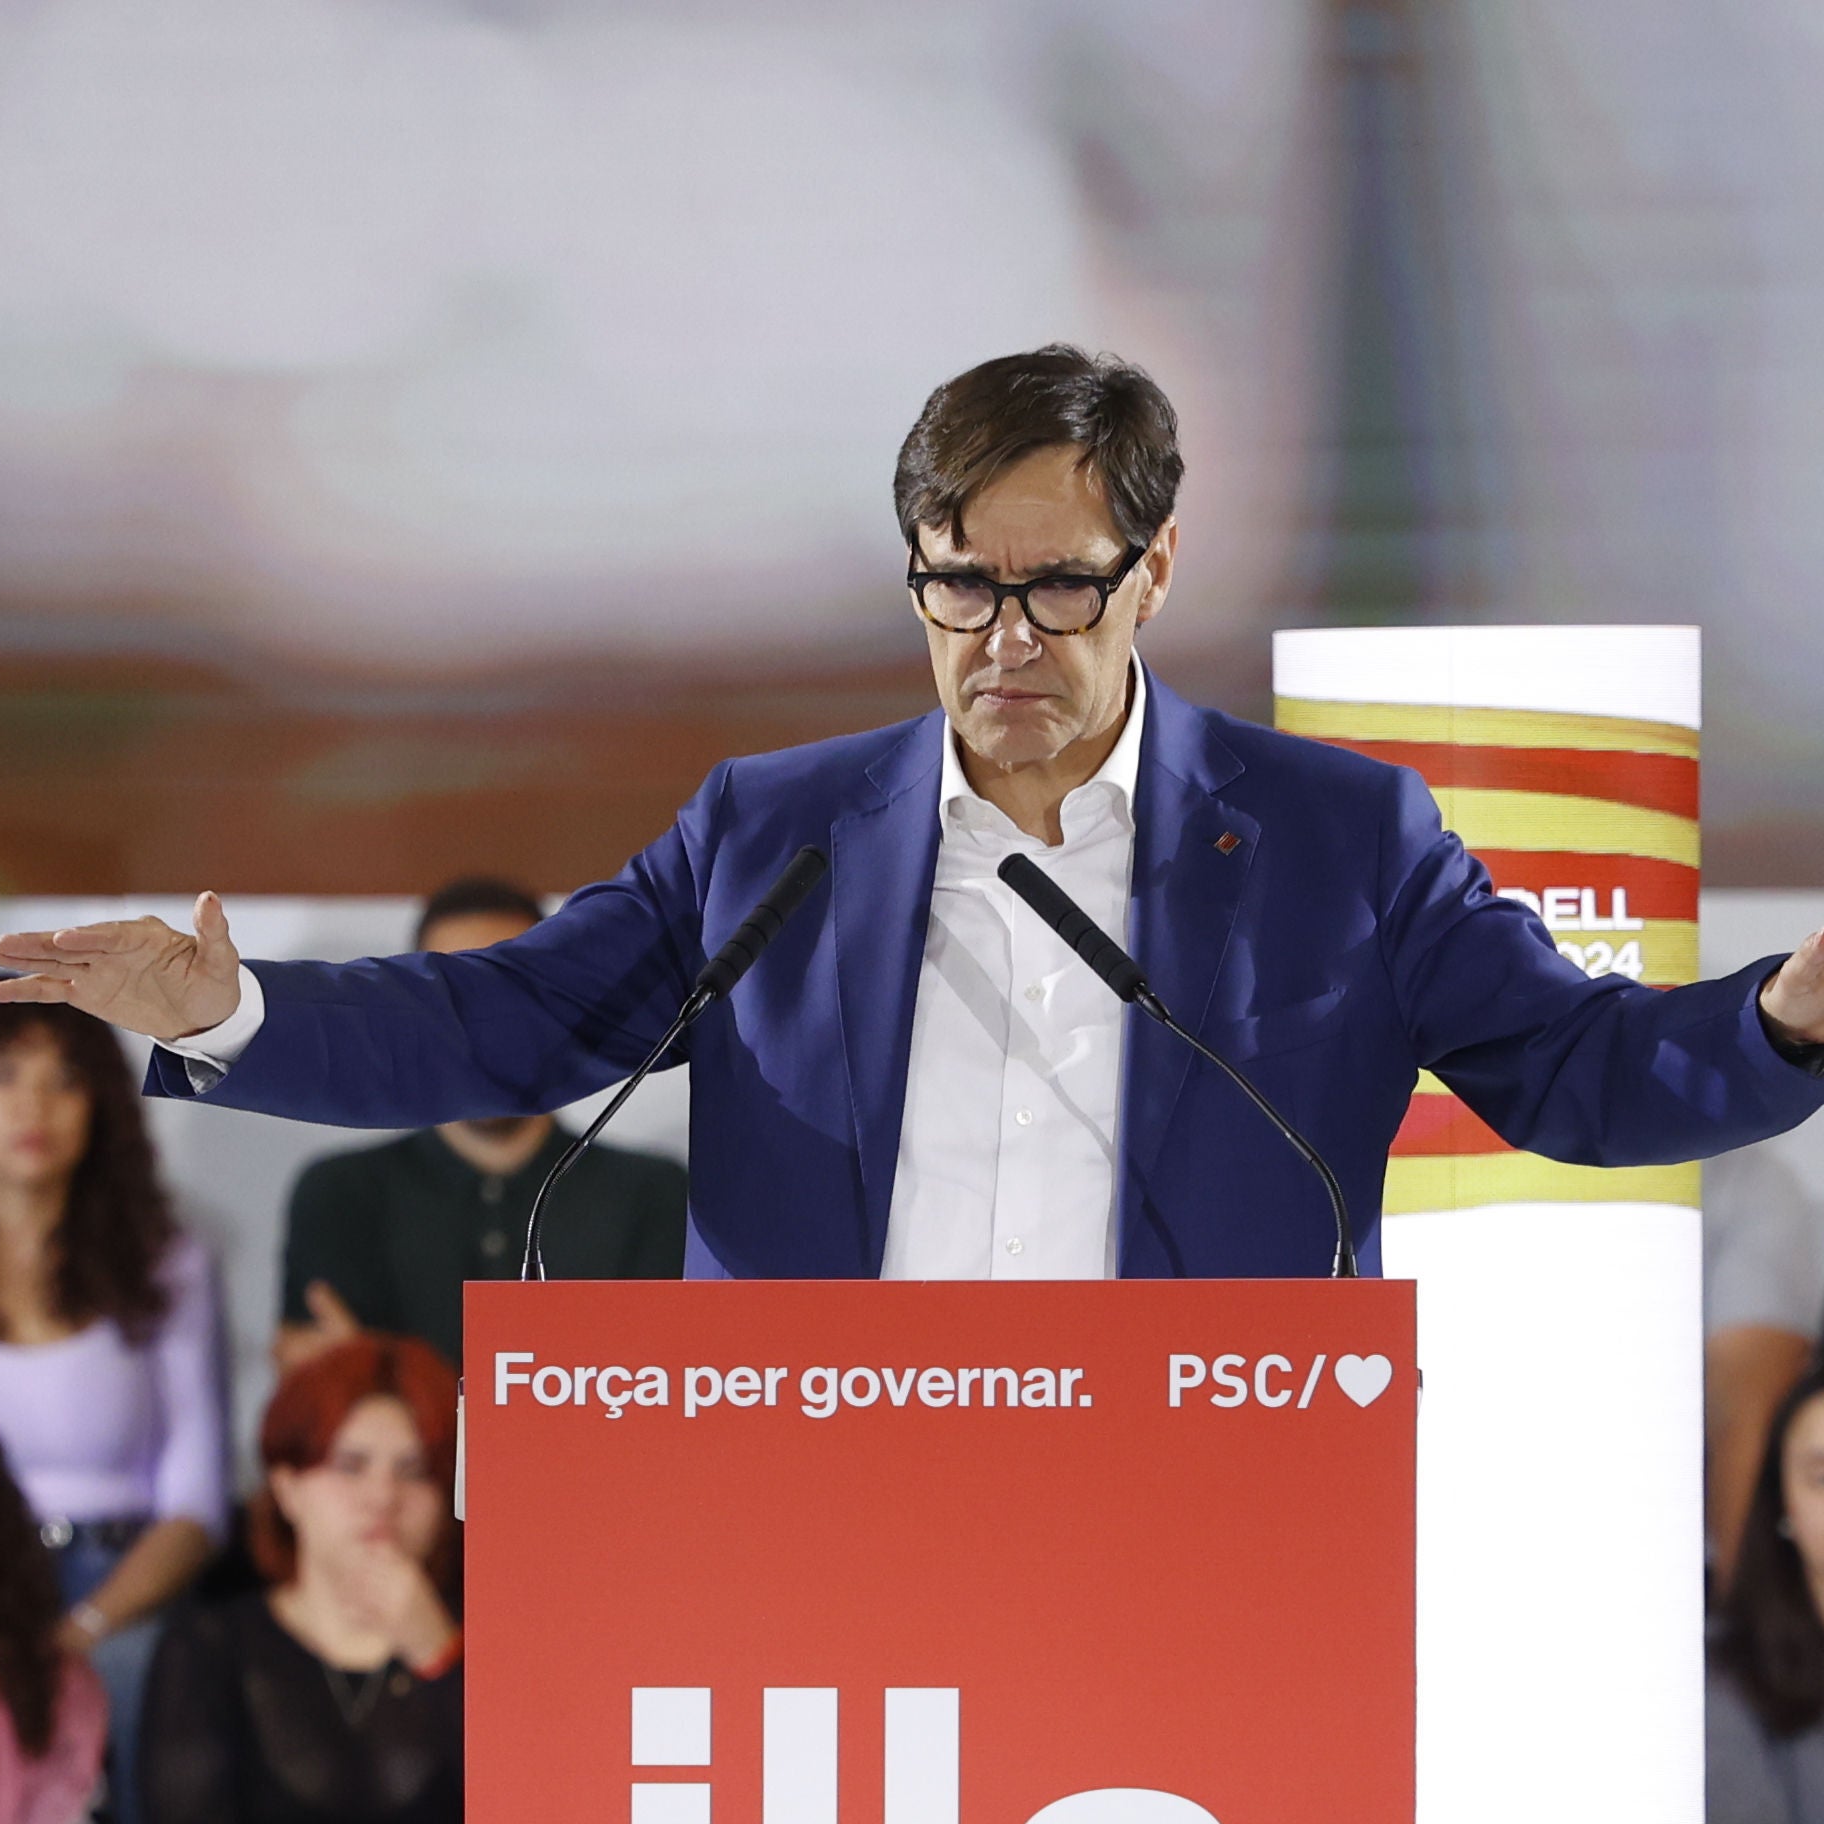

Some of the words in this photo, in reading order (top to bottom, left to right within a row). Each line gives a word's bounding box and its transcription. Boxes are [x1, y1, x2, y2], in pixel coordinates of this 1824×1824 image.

[494, 1351, 669, 1419] Força
[683, 1365, 788, 1418] per
[800, 1365, 1093, 1419] governar.
